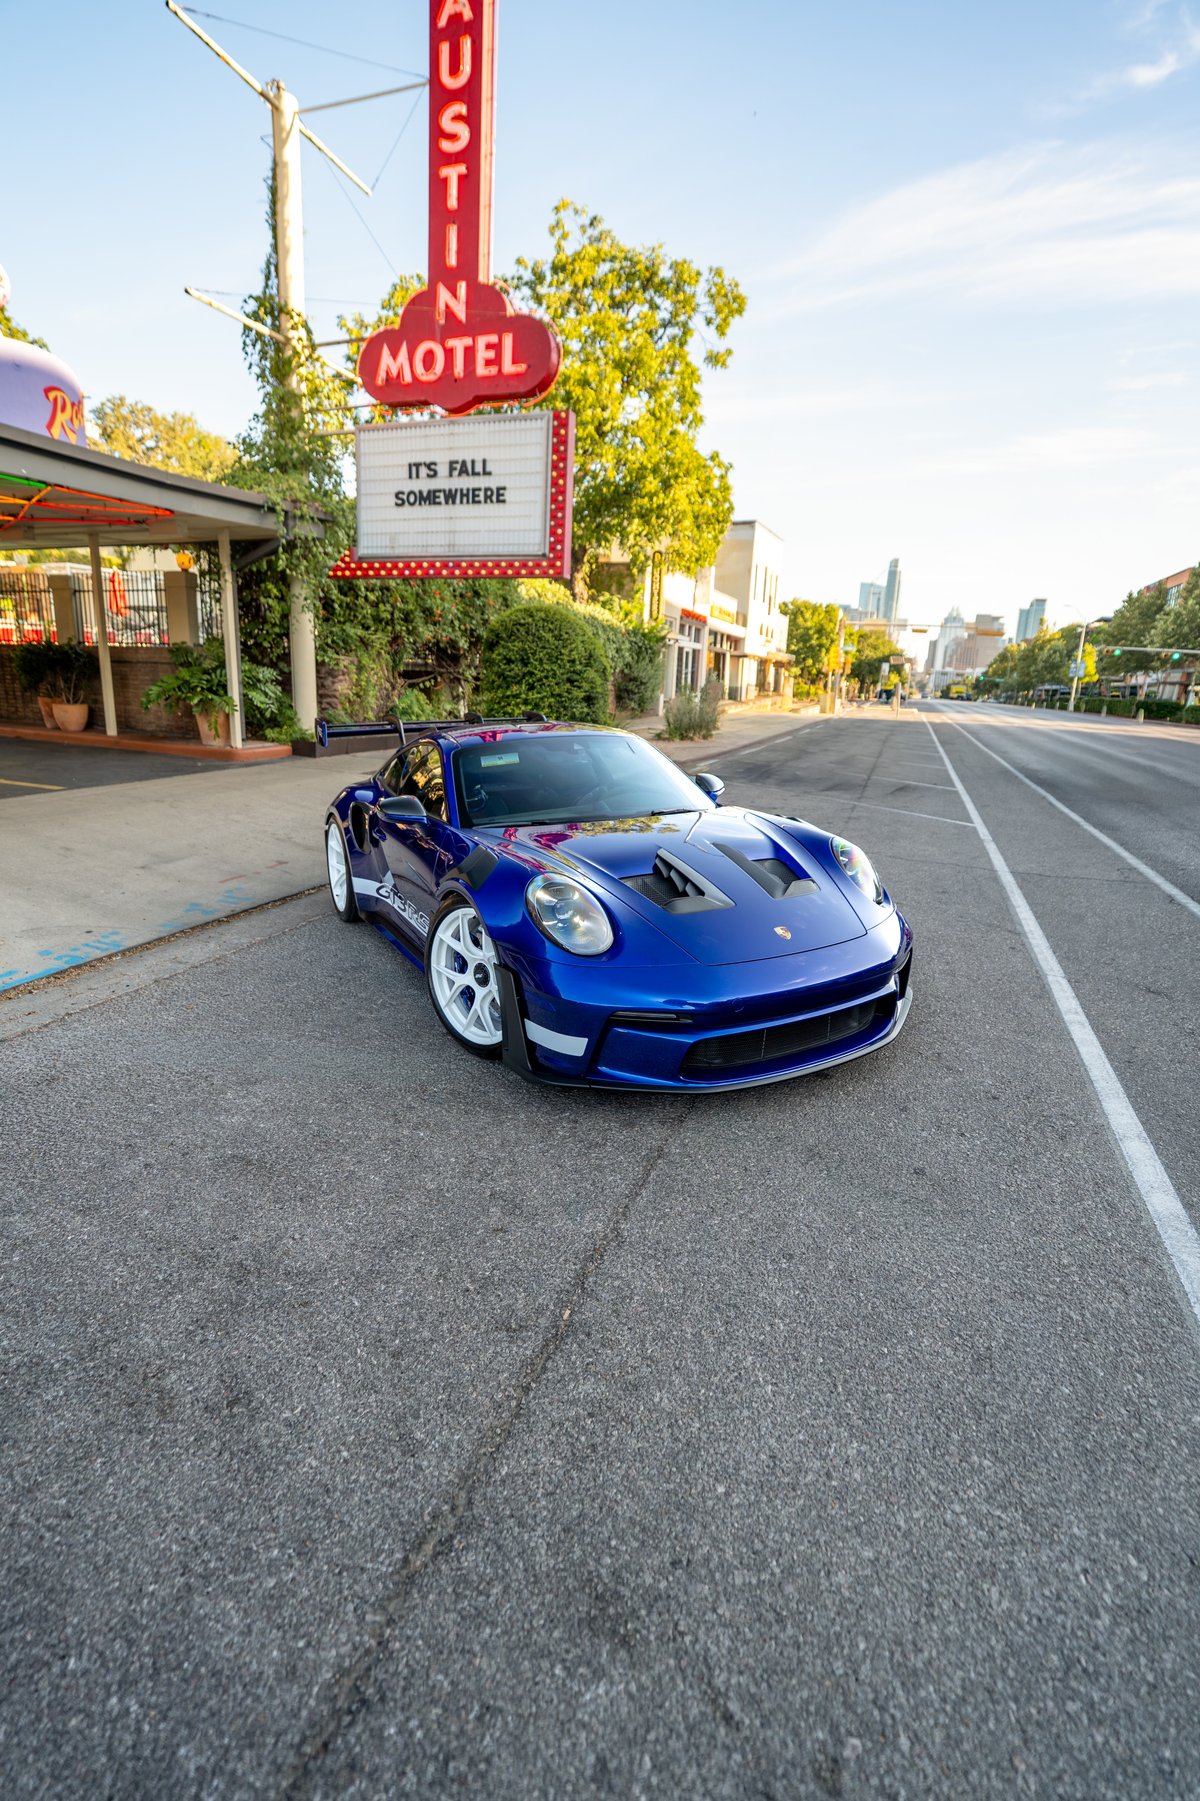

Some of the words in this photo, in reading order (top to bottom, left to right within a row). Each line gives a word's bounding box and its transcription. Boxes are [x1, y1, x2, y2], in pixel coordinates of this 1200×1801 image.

[436, 0, 474, 325] AUSTIN
[375, 332, 528, 387] MOTEL
[408, 460, 438, 479] IT'S
[448, 458, 492, 477] FALL
[394, 485, 507, 507] SOMEWHERE
